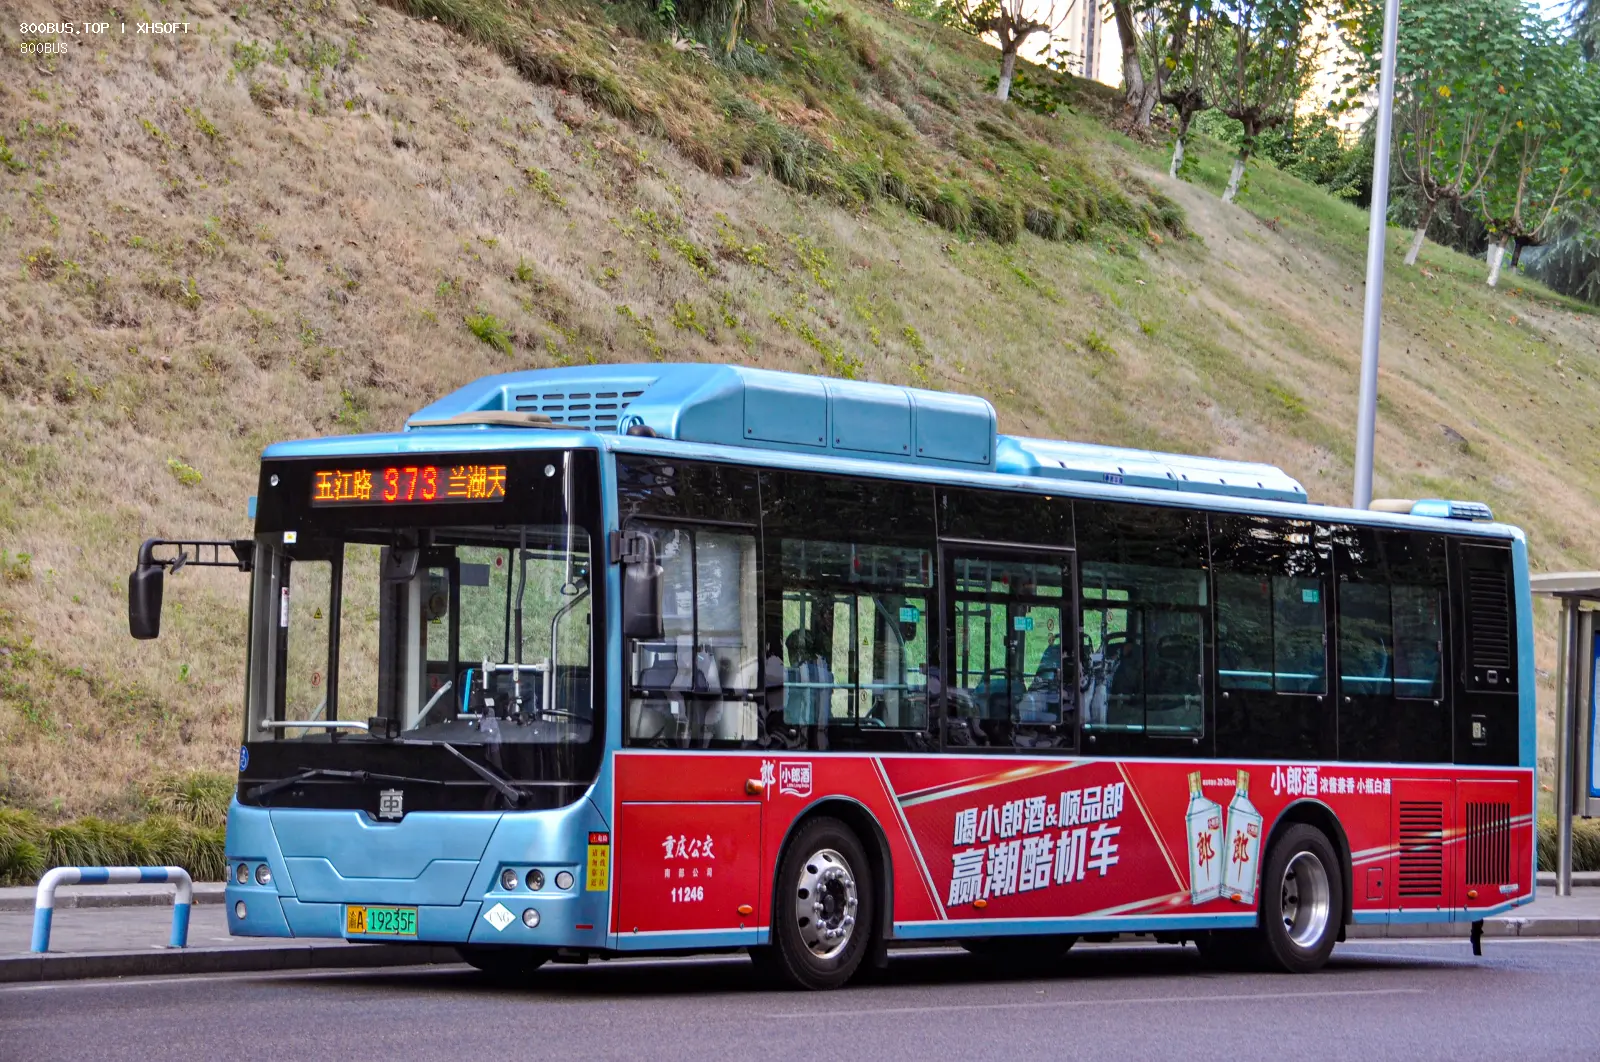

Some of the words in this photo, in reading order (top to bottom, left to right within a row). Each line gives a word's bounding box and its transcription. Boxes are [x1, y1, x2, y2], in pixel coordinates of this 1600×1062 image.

[314, 469, 373, 501] 五江路
[383, 466, 438, 501] 373
[447, 465, 507, 499] 兰湖天
[781, 767, 810, 784] 小郎酒
[1270, 765, 1318, 796] 小郎酒
[1357, 778, 1391, 795] 小瓶白酒
[953, 781, 1125, 847] 喝小郎酒&顺品郎
[661, 834, 716, 860] 重庆公交
[947, 823, 1121, 907] 赢潮酷机车
[671, 886, 704, 903] 11246
[489, 912, 510, 923] CNG
